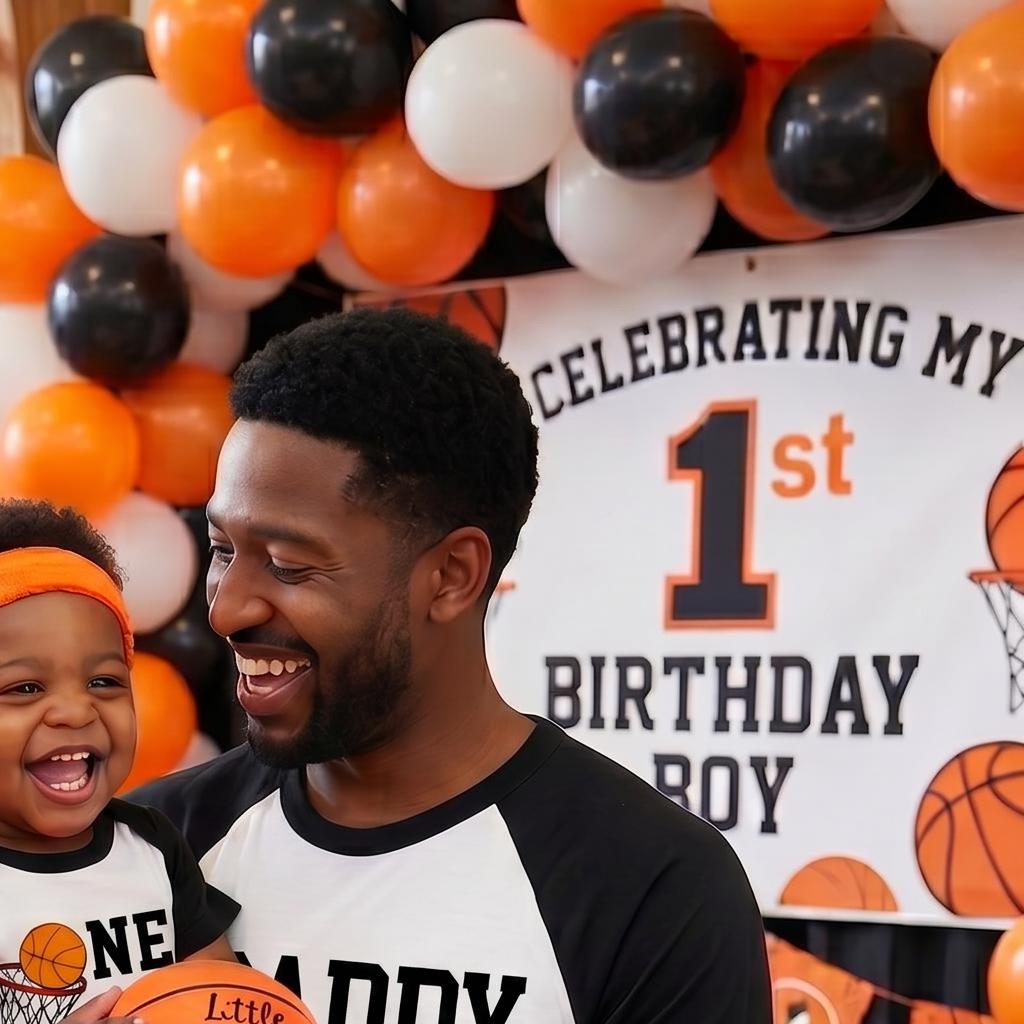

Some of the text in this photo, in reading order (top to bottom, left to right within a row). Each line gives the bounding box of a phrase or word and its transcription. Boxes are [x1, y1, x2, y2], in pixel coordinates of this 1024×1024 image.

[531, 299, 1024, 421] CELEBRATING MY
[665, 398, 854, 631] 1st
[545, 655, 920, 735] BIRTHDAY
[653, 754, 794, 833] BOY
